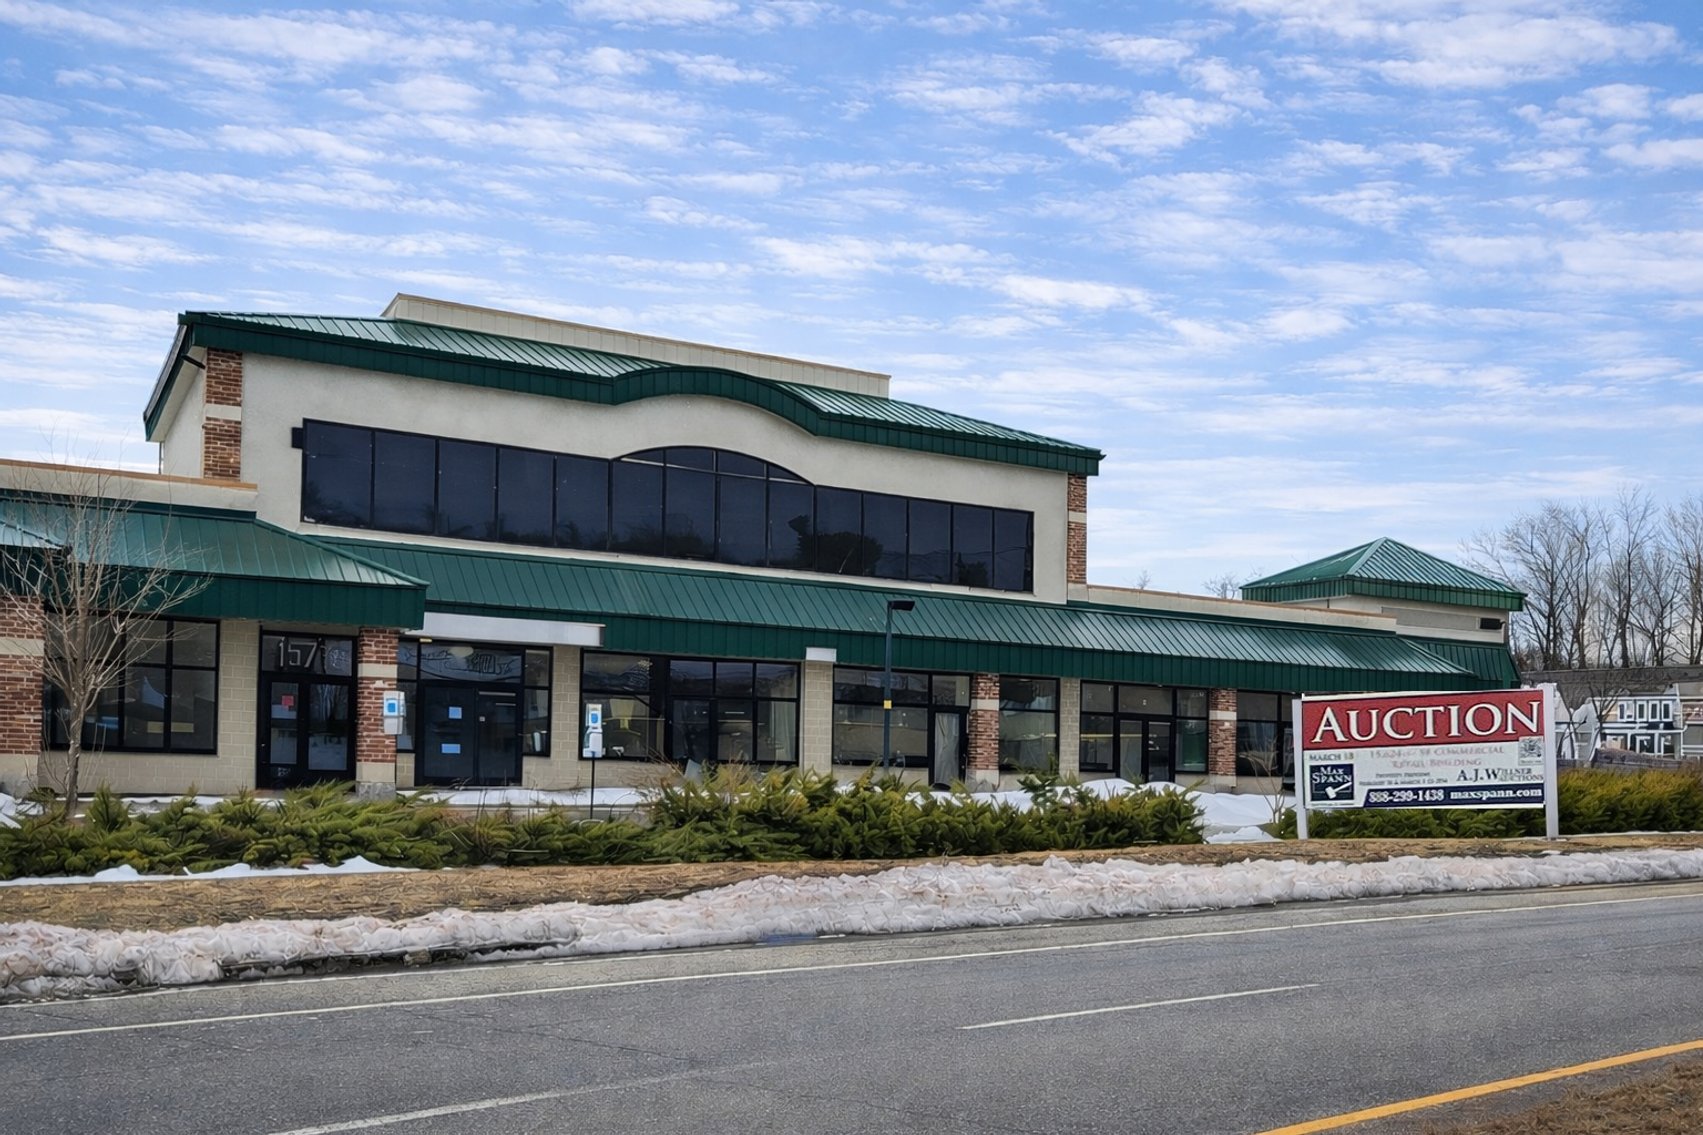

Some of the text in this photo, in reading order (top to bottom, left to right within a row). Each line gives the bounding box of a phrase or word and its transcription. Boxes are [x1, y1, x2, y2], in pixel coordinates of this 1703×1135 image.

[279, 642, 317, 668] 157
[1311, 701, 1541, 743] AUCTION
[1309, 753, 1342, 761] MARCH
[1320, 766, 1345, 775] MAX
[1312, 772, 1352, 783] SPANN
[1450, 789, 1542, 800] maxspann.com
